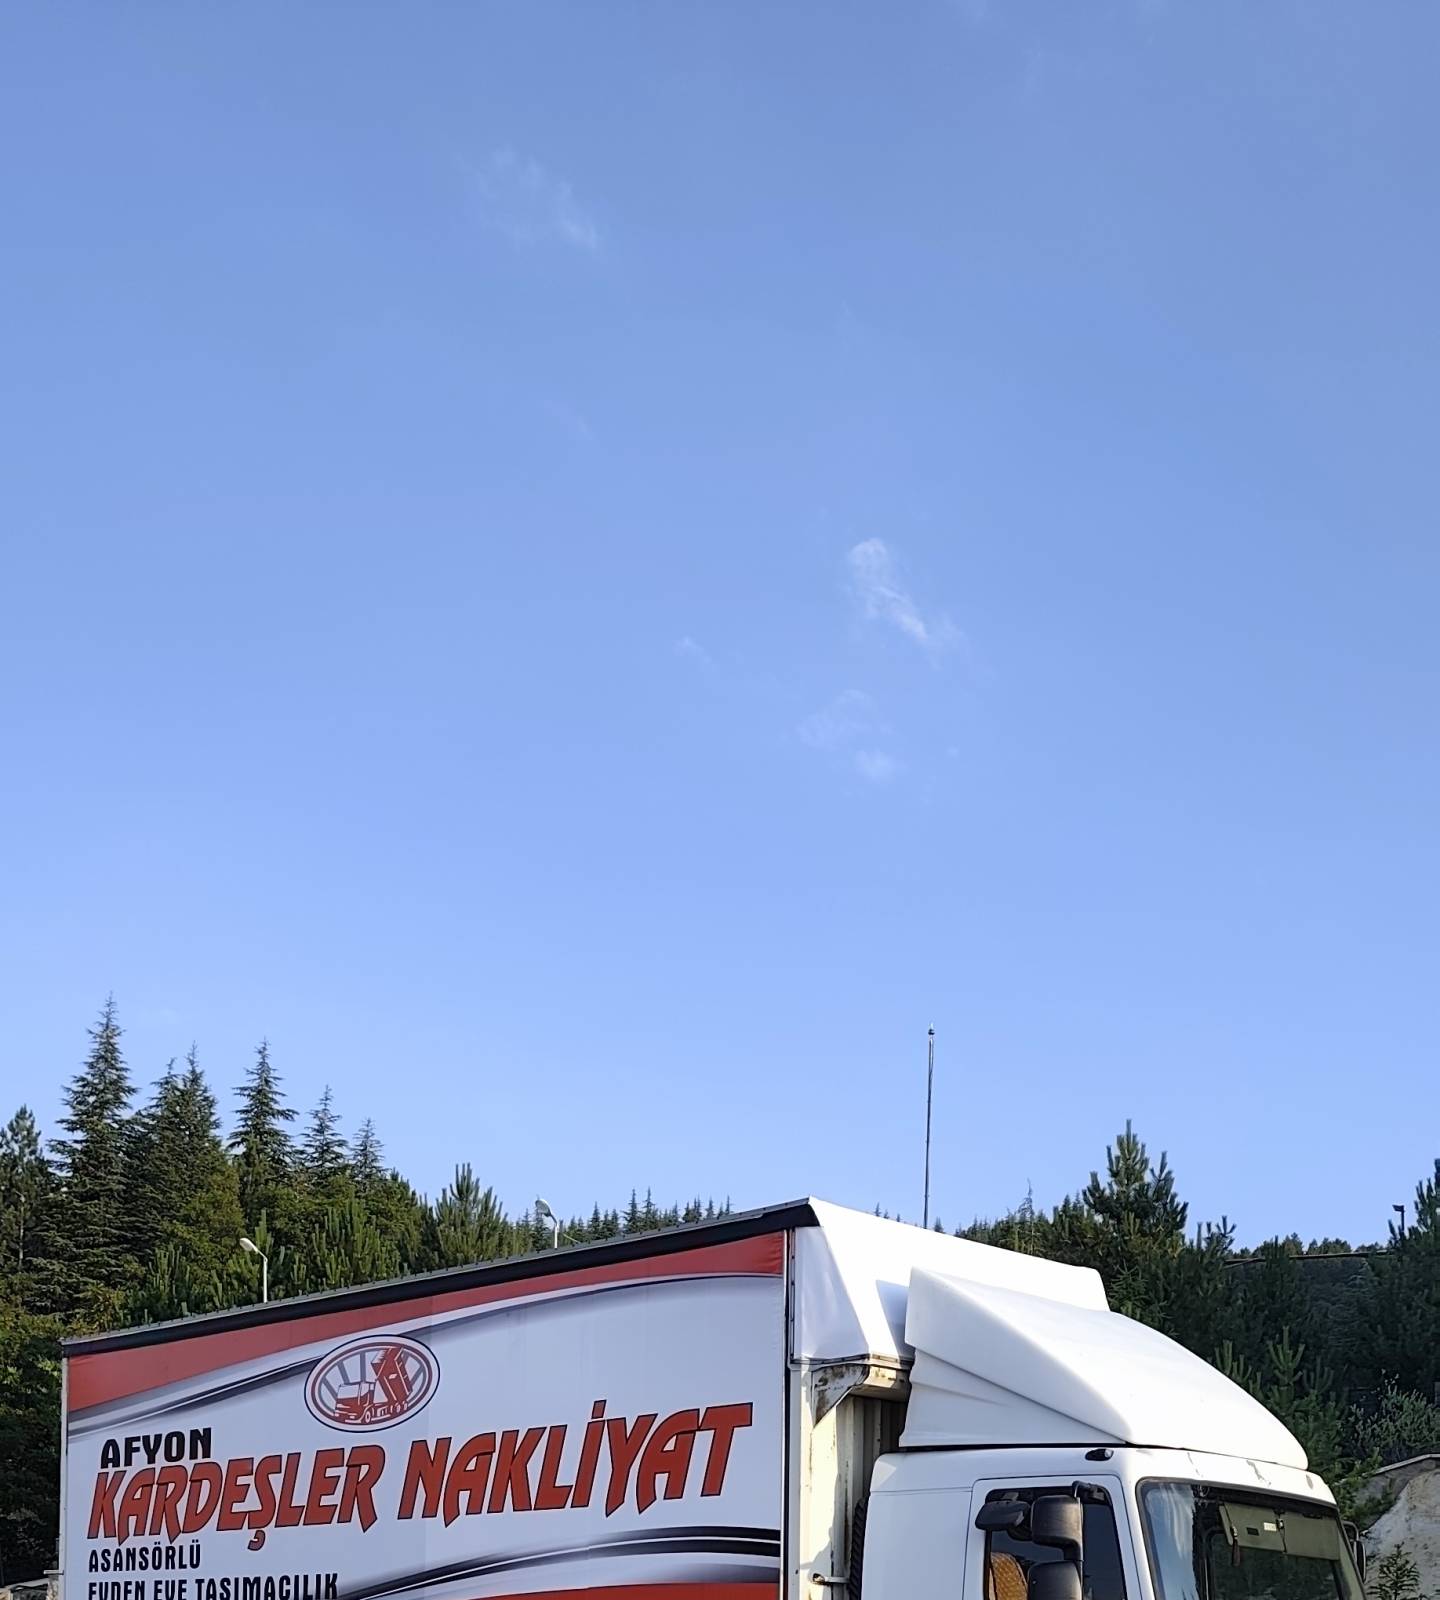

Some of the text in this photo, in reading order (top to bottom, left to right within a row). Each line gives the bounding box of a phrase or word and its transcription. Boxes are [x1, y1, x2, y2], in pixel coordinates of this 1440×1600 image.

[100, 1427, 212, 1468] AFYON
[87, 1400, 753, 1551] KARDEŞLER NAKLİYAT
[88, 1541, 201, 1573] ASANSÖRLÜ
